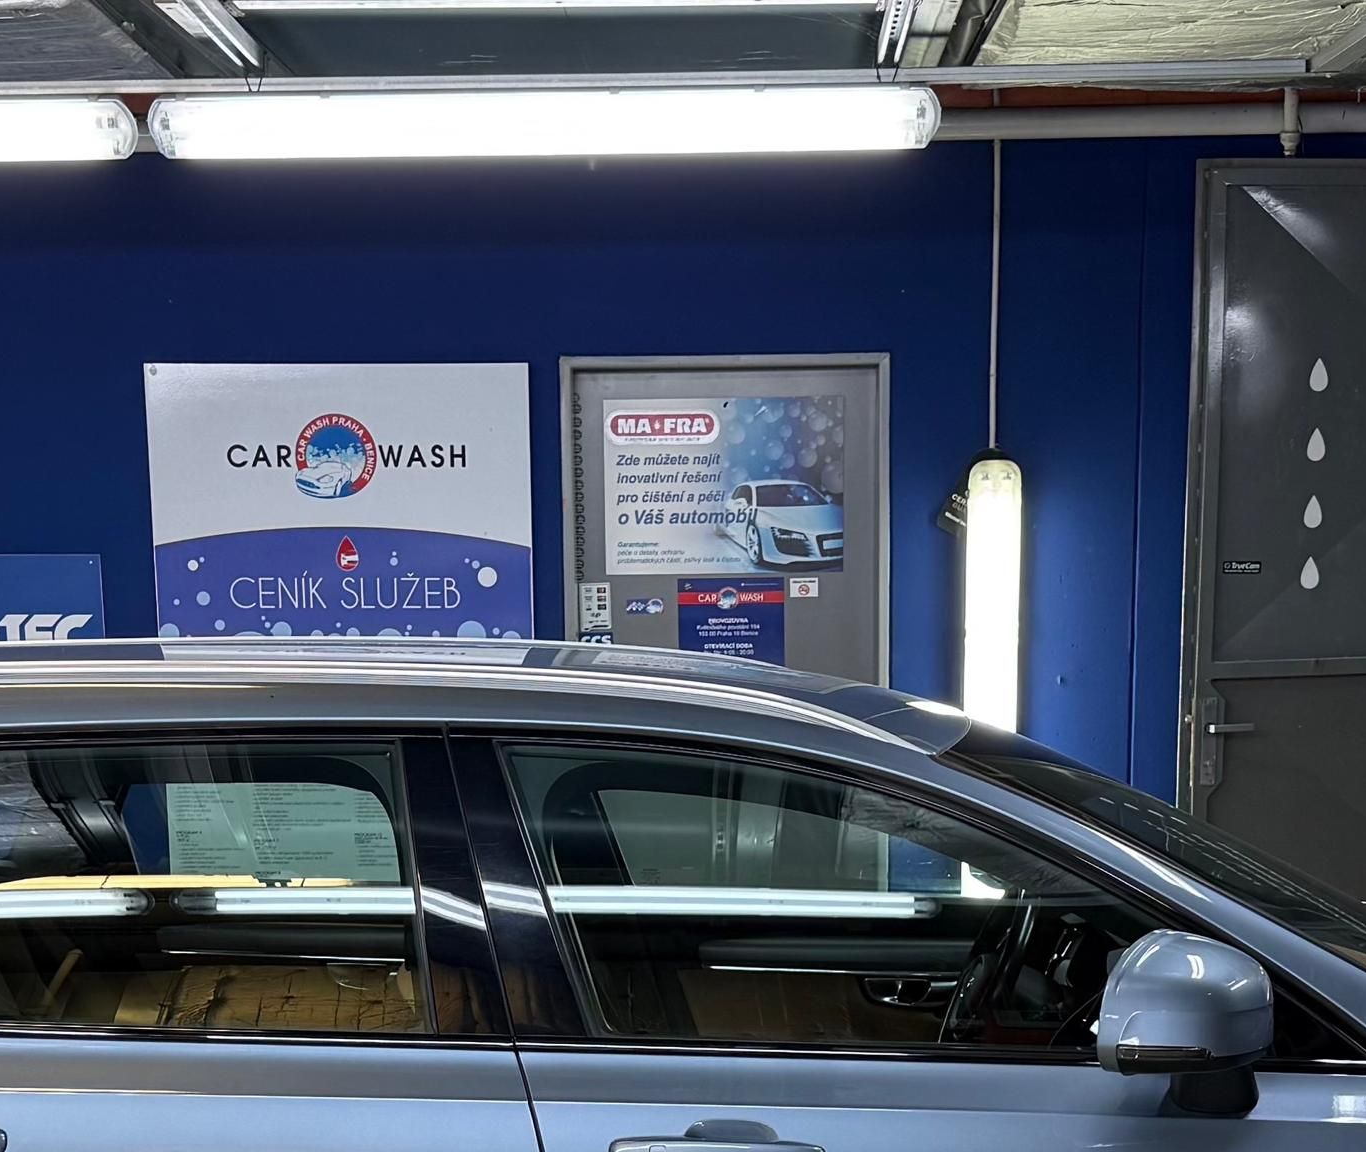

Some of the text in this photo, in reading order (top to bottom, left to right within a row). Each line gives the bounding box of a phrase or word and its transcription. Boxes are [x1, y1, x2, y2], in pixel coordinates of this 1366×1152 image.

[226, 444, 467, 468] CAR WASH
[616, 454, 640, 466] Zde
[693, 452, 720, 467] najít
[617, 470, 722, 484] inovativní řešení
[617, 493, 638, 505] pro
[618, 513, 629, 525] o
[635, 508, 664, 525] Váš
[230, 570, 461, 609] CENÍK SLUŽEB
